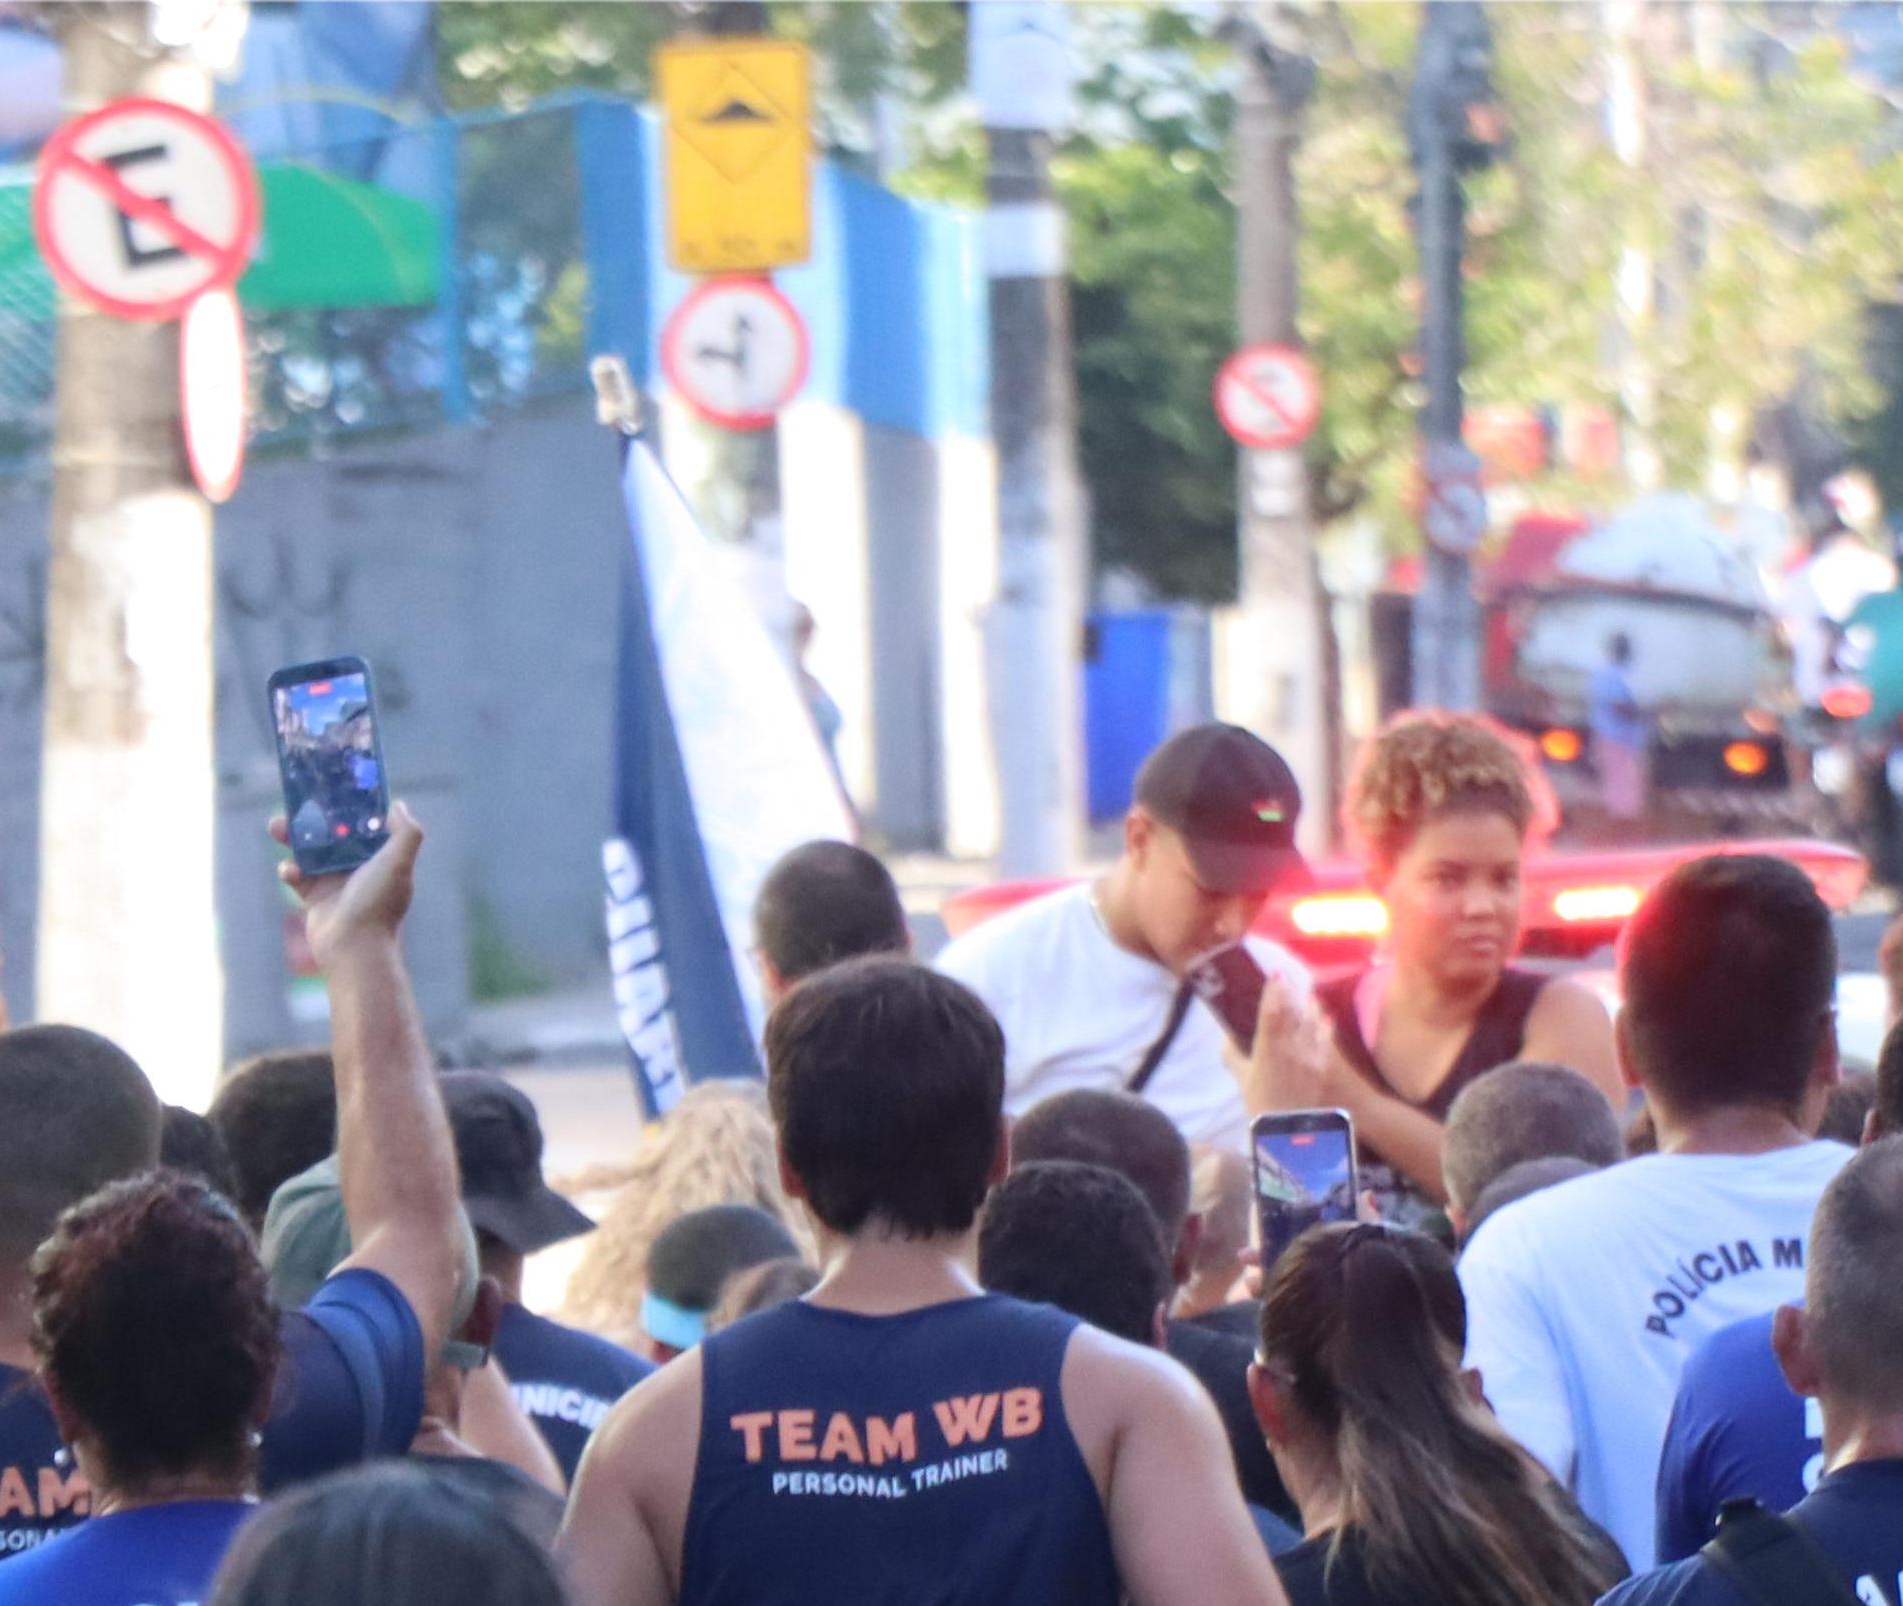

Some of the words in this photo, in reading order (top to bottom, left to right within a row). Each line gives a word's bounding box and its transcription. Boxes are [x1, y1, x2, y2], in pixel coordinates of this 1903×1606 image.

[1645, 1239, 1763, 1341] POLÍCIA
[730, 1408, 917, 1466] TEAM
[932, 1386, 1044, 1448] WB
[772, 1469, 909, 1499] PERSONAL
[910, 1446, 1010, 1493] TRAINER
